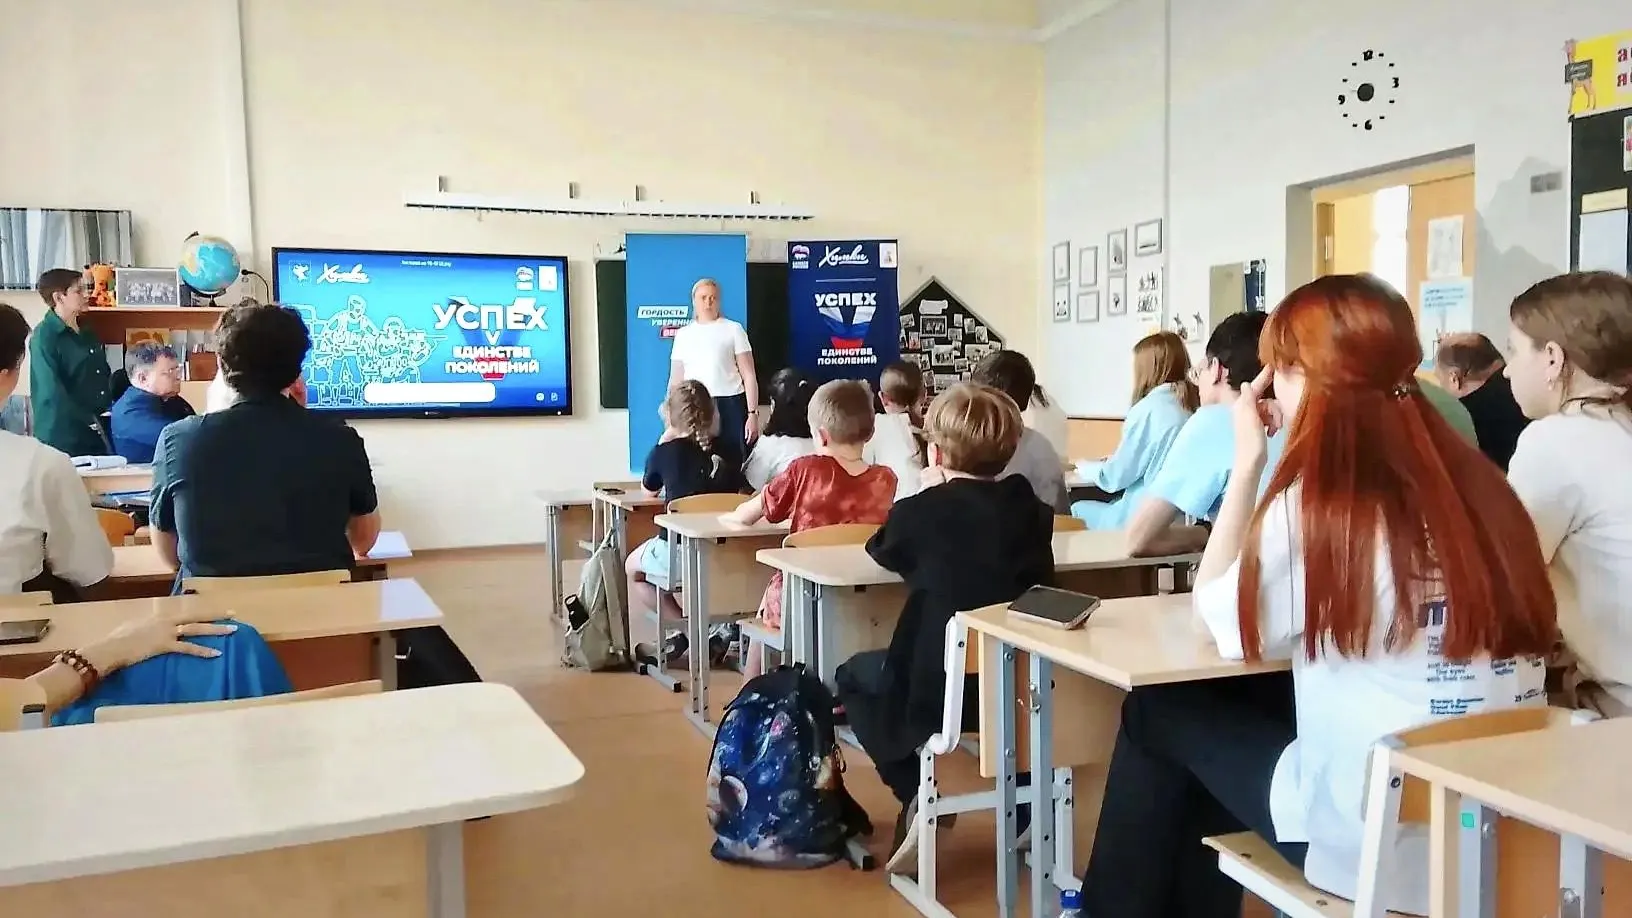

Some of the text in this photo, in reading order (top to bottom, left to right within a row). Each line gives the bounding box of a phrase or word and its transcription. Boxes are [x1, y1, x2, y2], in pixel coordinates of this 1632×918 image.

[1392, 76, 1400, 88] 3
[1338, 94, 1346, 105] 9
[1364, 119, 1373, 130] 6
[814, 292, 877, 307] УСПЕХ
[432, 303, 549, 331] УСПЕХ
[452, 345, 532, 359] ЕДИНСТВЕ
[821, 347, 873, 357] ЕДИНСТВЕ
[817, 354, 878, 366] ПОКОЛЕНИЙ
[445, 360, 540, 374] ПОКОЛЕНИЙ
